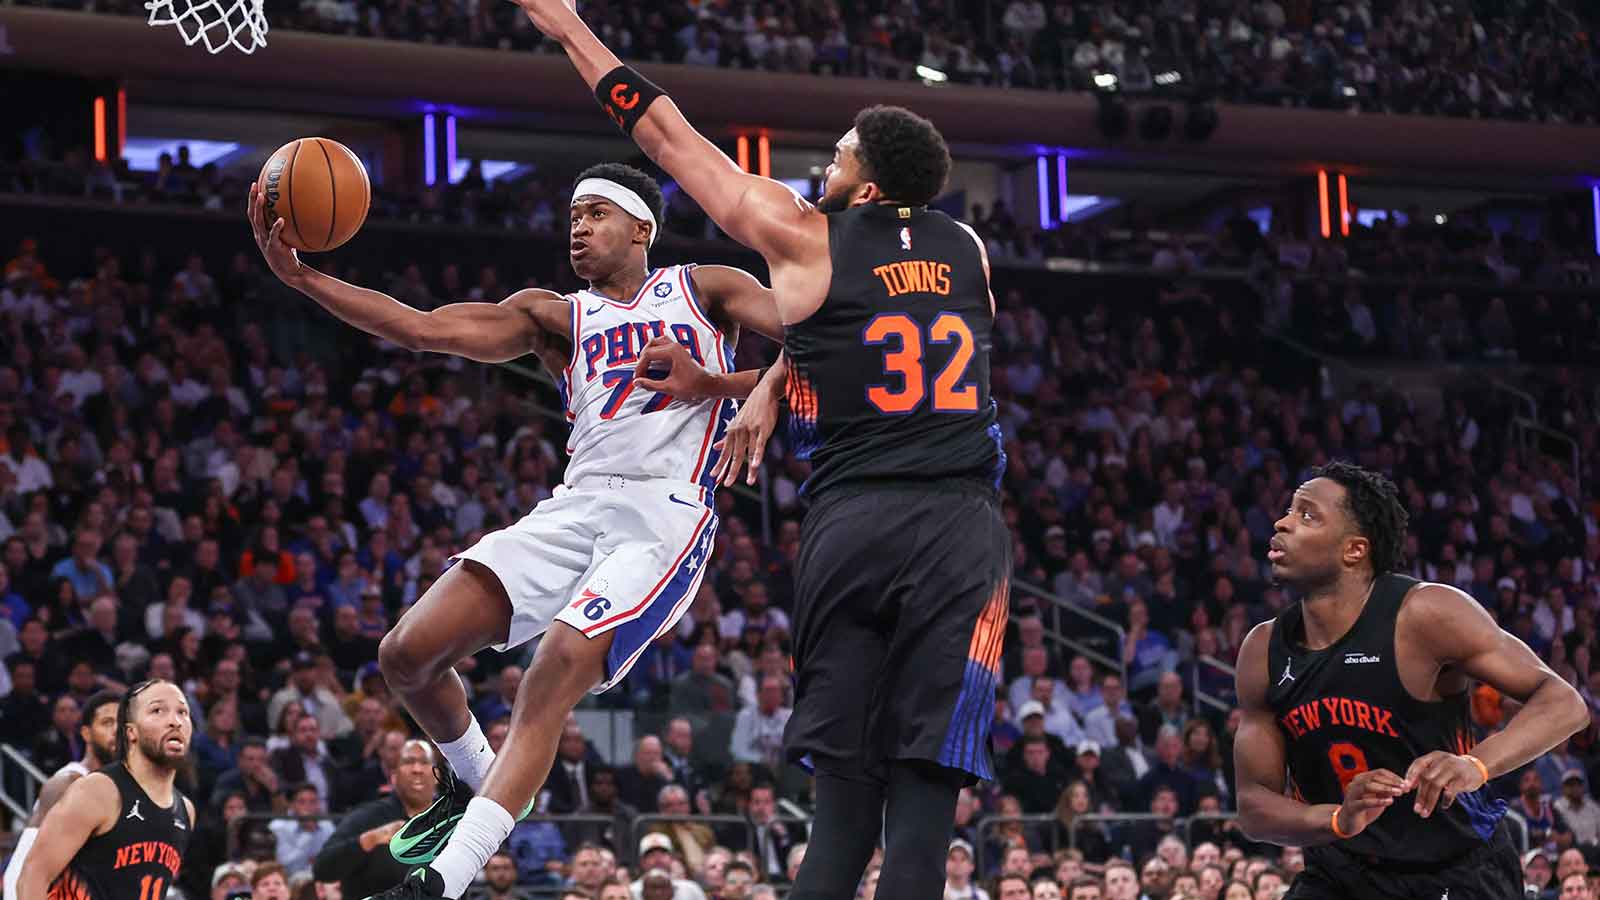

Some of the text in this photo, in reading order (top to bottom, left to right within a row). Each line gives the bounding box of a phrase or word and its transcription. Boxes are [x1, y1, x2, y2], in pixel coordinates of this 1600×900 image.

[873, 261, 952, 297] TOWNS
[863, 312, 979, 415] 32
[570, 588, 612, 621] 76
[1280, 697, 1399, 739] NEW YORK
[114, 842, 181, 876] NEW YOR
[139, 875, 163, 900] 11
